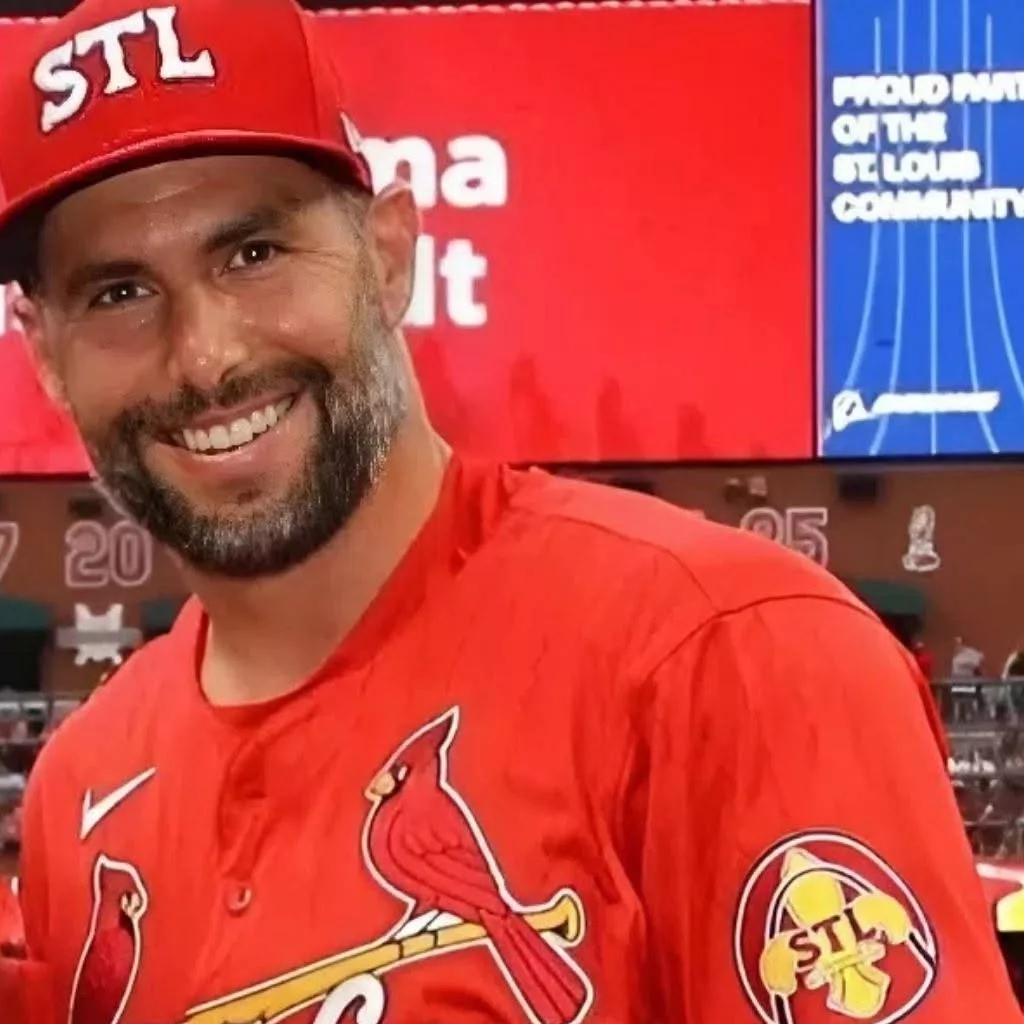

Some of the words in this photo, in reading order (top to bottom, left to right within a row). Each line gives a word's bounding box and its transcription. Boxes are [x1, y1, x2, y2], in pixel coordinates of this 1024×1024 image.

[33, 6, 216, 133] STL
[832, 74, 951, 107] PROUD
[832, 114, 879, 145] OF
[880, 111, 948, 144] THE
[881, 150, 982, 183] LOUIS
[831, 186, 1024, 224] COMMUNITY
[64, 520, 152, 588] 20
[788, 908, 891, 970] STL
